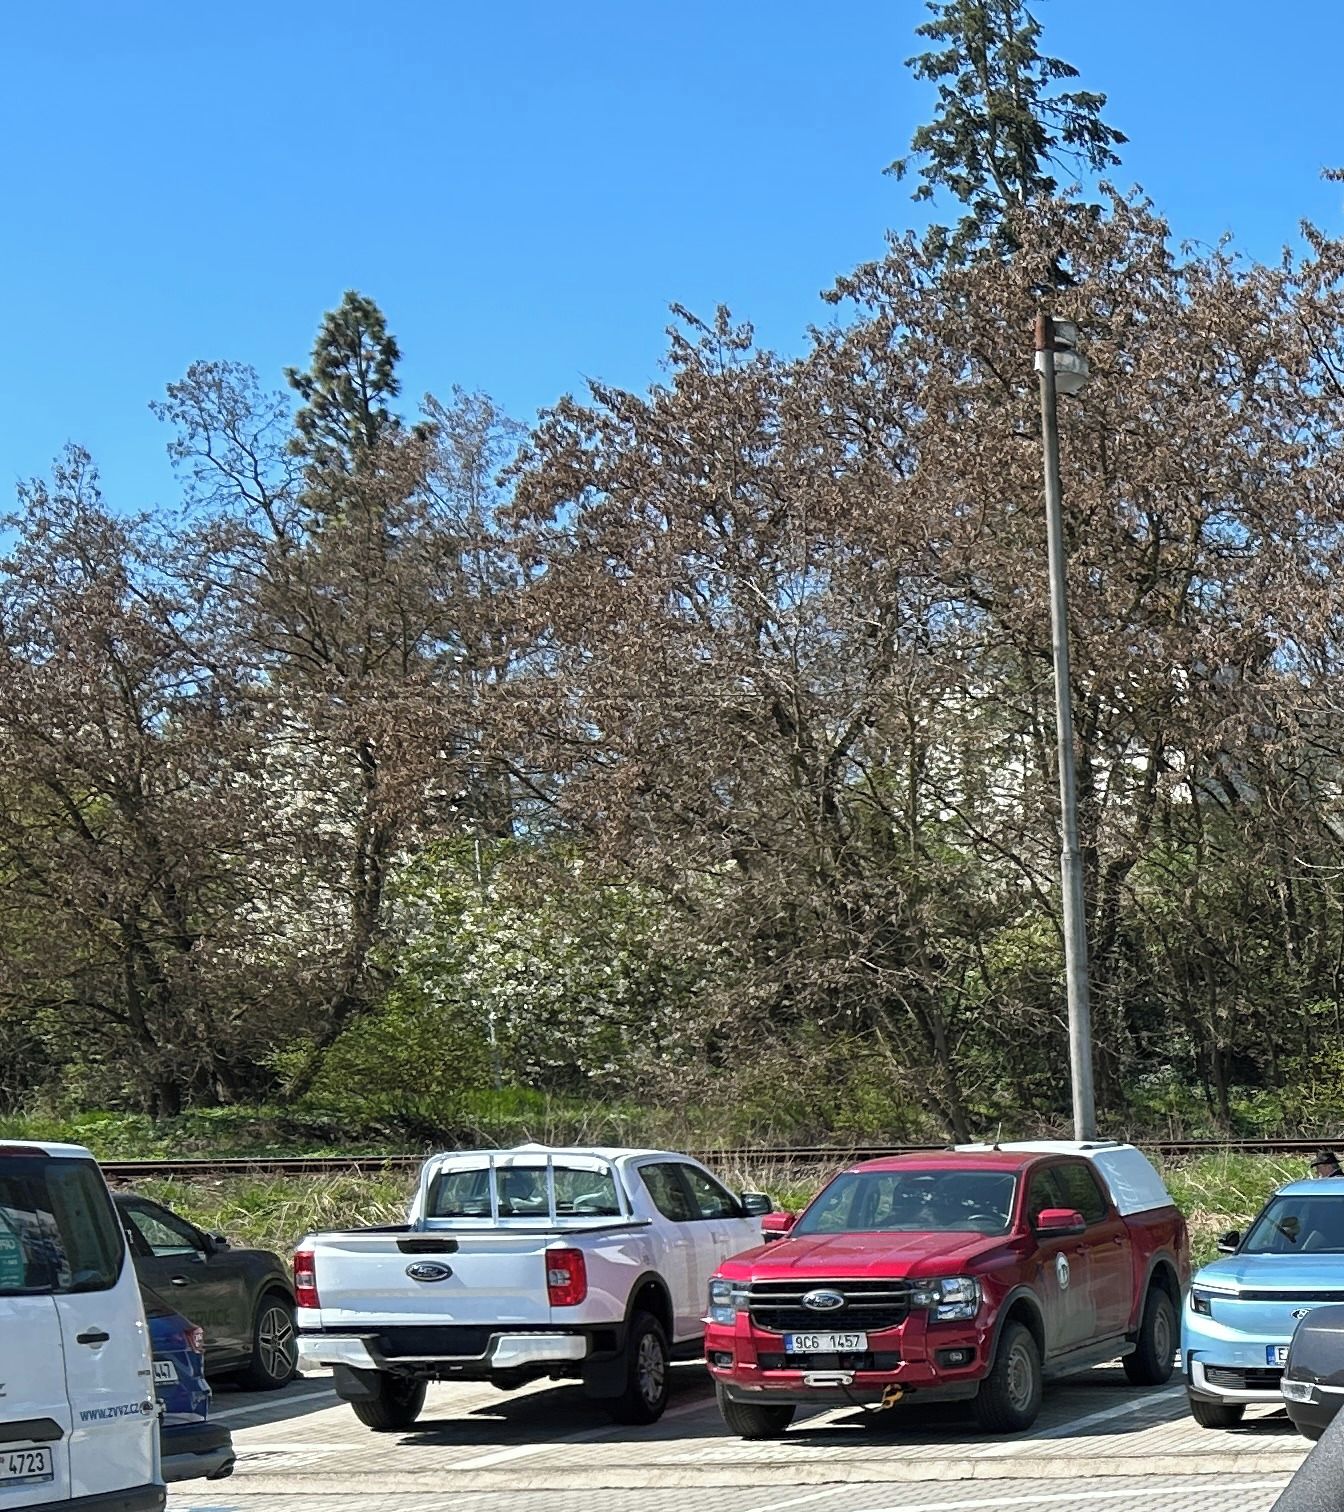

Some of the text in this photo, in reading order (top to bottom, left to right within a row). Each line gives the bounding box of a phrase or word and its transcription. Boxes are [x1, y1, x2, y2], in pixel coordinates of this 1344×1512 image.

[796, 1335, 860, 1348] 9C6 1457
[9, 1452, 45, 1473] 4723
